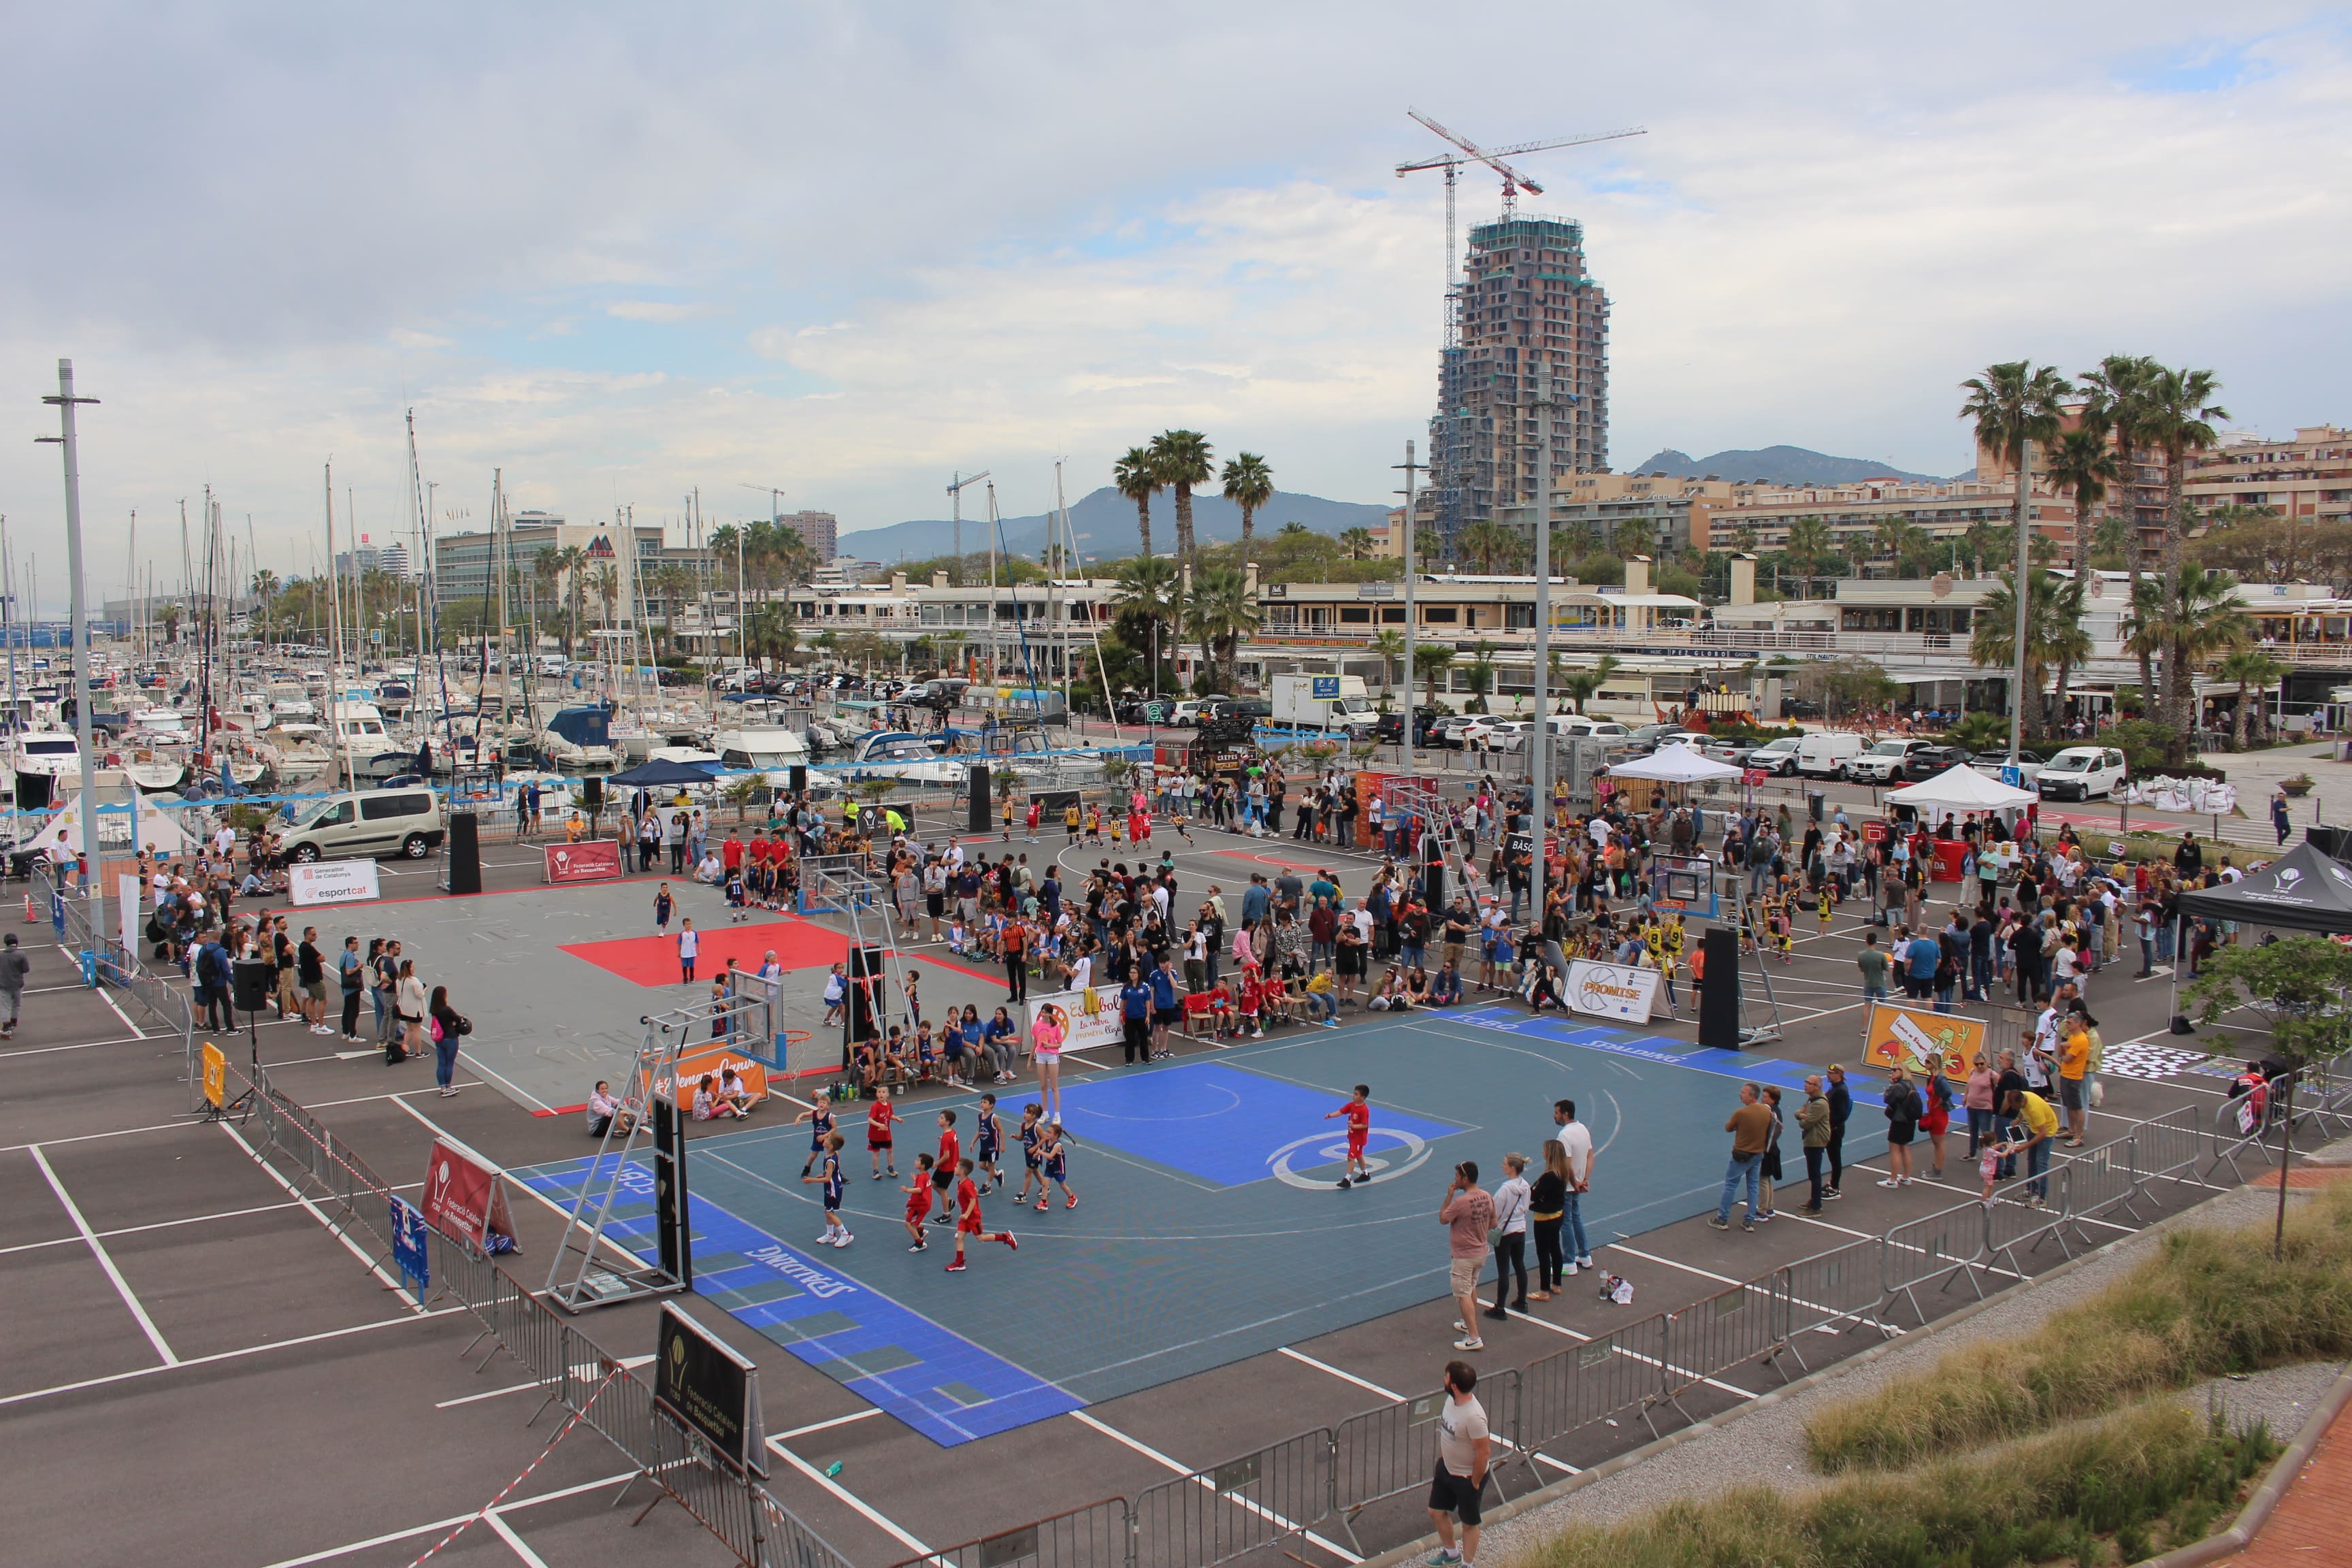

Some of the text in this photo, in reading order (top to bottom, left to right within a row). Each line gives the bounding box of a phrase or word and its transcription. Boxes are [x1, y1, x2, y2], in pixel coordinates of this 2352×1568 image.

[1144, 818, 1150, 826] 15
[318, 886, 366, 898] esportcat
[733, 885, 740, 894] 11
[1652, 934, 1659, 944] 8
[1671, 932, 1679, 943] 9
[1584, 981, 1641, 1000] PROMISE
[1454, 1015, 1519, 1030] FCBQ
[1105, 1026, 1122, 1036] lliga
[1582, 1040, 1688, 1063] SPALDING
[431, 1202, 441, 1212] FCBQ
[446, 1197, 482, 1227] Federació Catalana
[450, 1212, 473, 1232] Basquetbol
[744, 1245, 858, 1298] SPALDING
[670, 1388, 681, 1402] FCBQ
[687, 1385, 737, 1433] Federació Catalana
[686, 1400, 724, 1438] de Basquetbol
